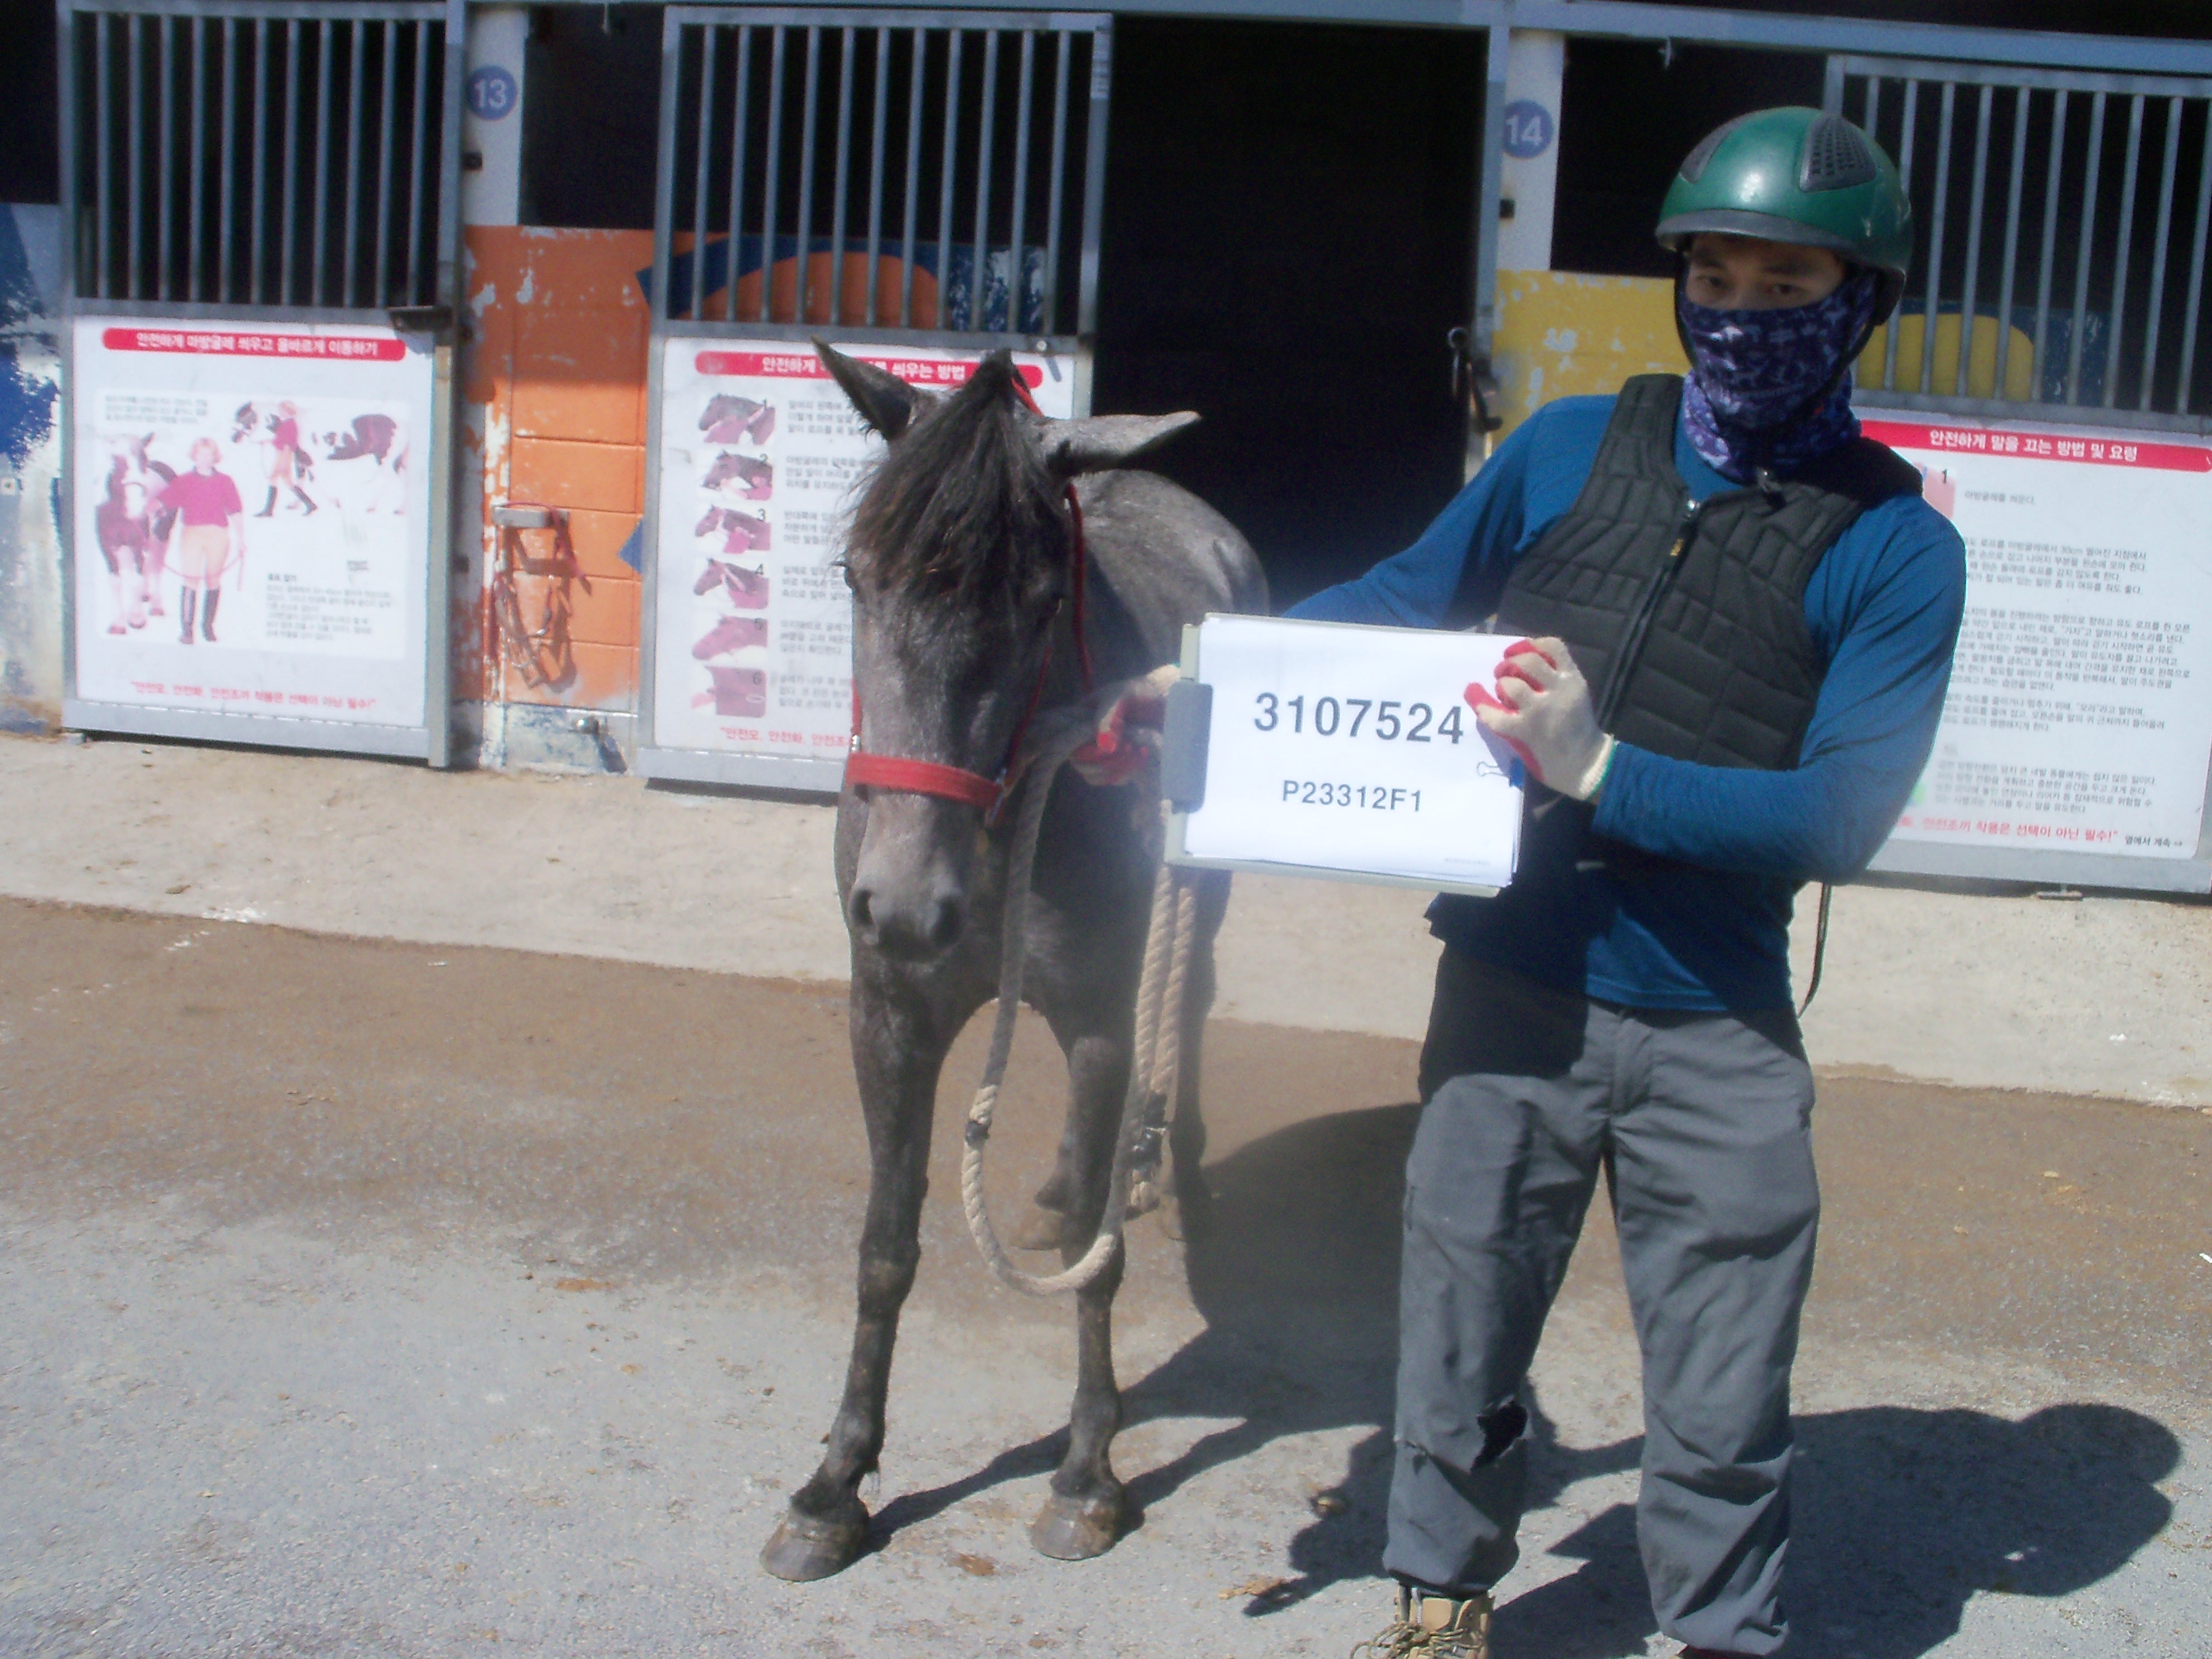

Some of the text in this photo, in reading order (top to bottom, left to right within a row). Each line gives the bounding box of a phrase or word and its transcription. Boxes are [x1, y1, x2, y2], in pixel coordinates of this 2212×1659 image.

[475, 79, 506, 108] 13
[1506, 114, 1542, 145] 14
[136, 332, 184, 350] 안전하게
[329, 338, 379, 356] 이동하기
[762, 357, 816, 374] 안전하게
[892, 363, 933, 380] 씌우는
[937, 365, 966, 381] 방법
[1930, 429, 2138, 463] 안전하게 말을 끄는 방법 및 요령
[1942, 469, 1949, 483] 1
[758, 508, 766, 522] 3
[755, 563, 764, 575] 4
[1254, 691, 1464, 745] 3107524
[1282, 779, 1422, 812] P23312F1
[2016, 823, 2051, 838] 선택이
[2056, 826, 2080, 841] 아닌
